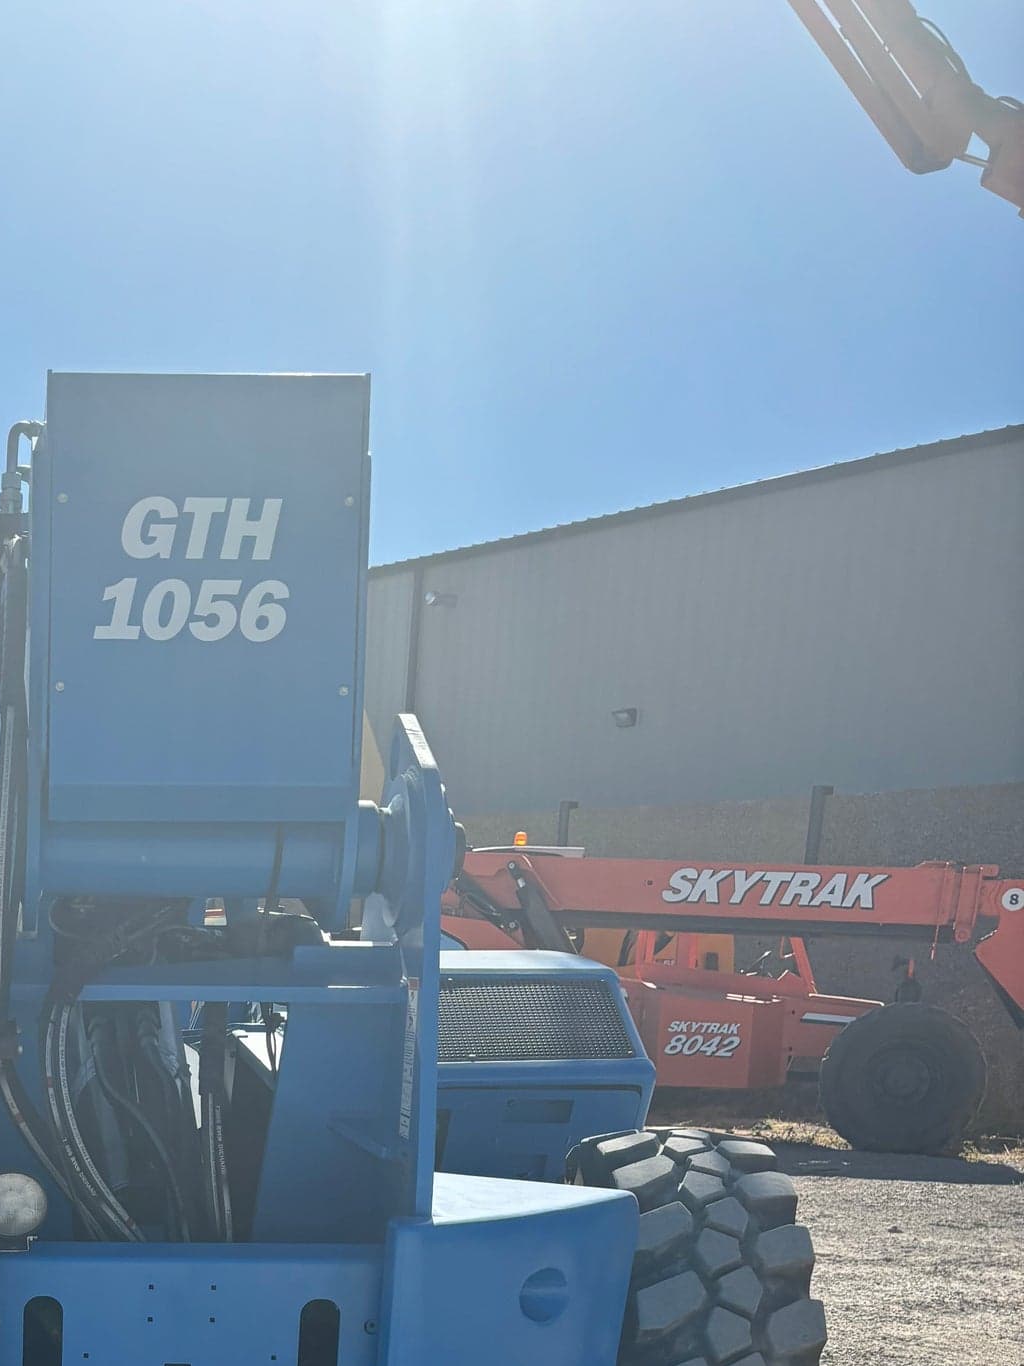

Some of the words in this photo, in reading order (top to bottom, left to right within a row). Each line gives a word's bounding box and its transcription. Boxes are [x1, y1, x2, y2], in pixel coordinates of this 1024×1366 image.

[121, 496, 283, 561] GTH
[93, 577, 290, 642] 1056
[662, 867, 890, 909] SKYTRAK
[1009, 893, 1020, 905] 8
[667, 1020, 741, 1034] SKYTRAK
[664, 1034, 742, 1057] 8042
